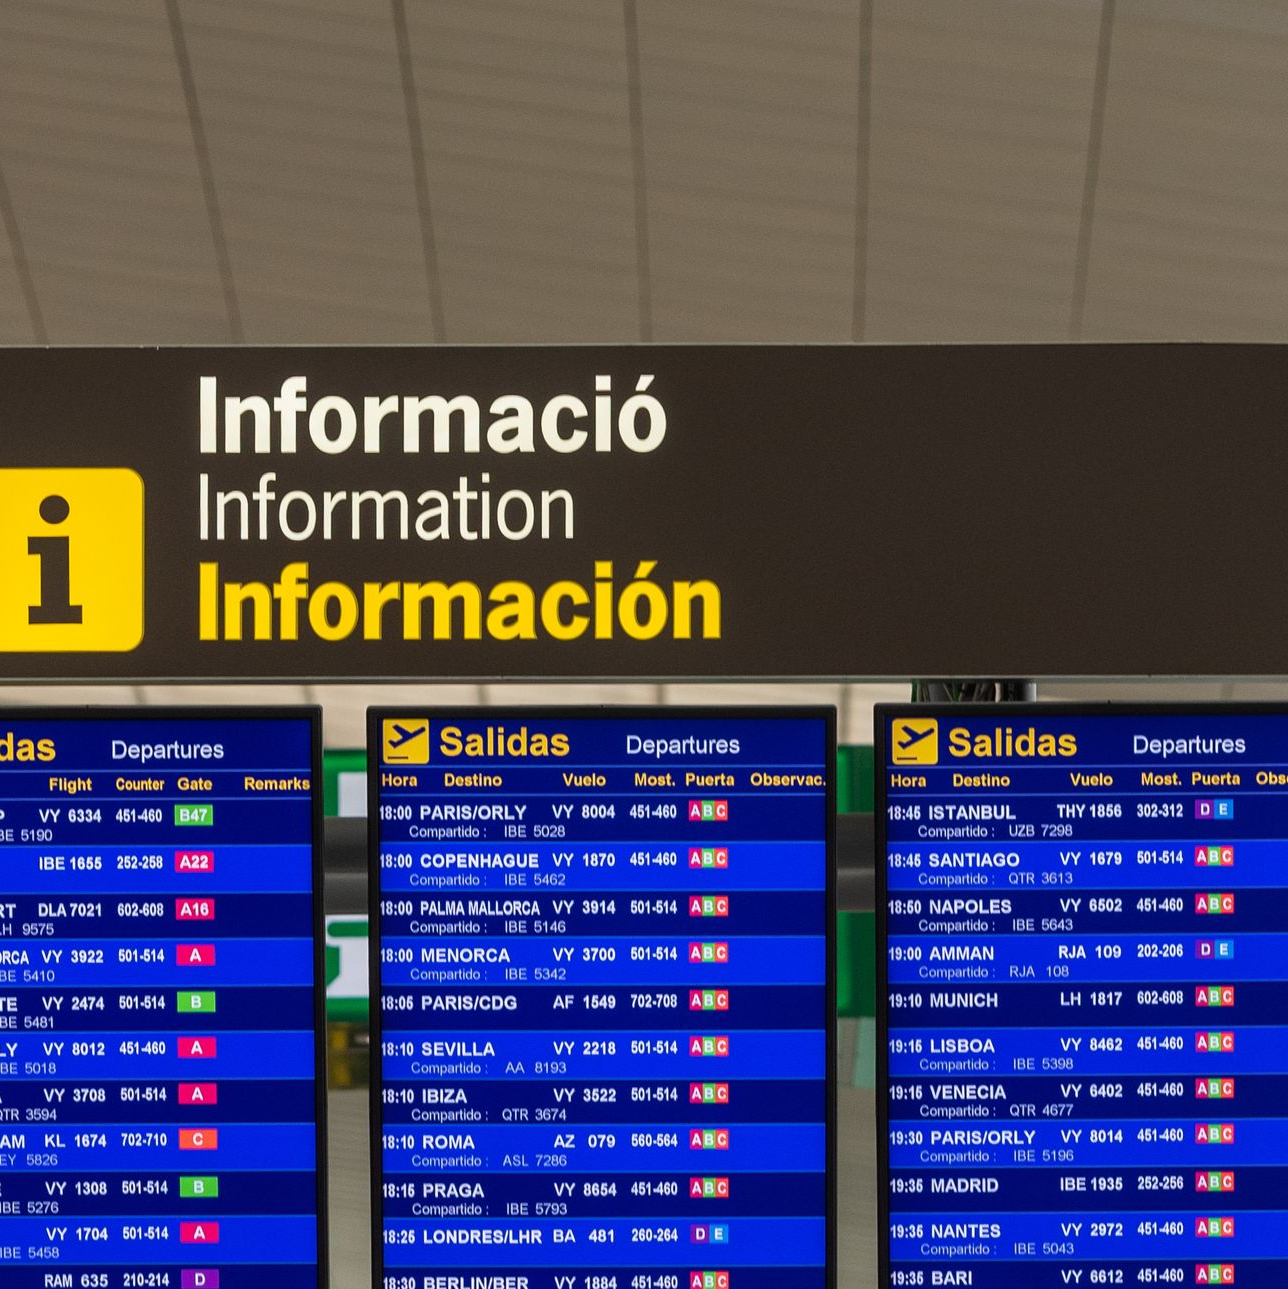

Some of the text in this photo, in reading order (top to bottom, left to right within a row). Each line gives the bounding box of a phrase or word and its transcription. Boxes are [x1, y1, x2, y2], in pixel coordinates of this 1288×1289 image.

[200, 375, 666, 454] Informació
[200, 472, 573, 540] Information
[200, 561, 720, 640] Información
[112, 741, 224, 763] Departures
[440, 727, 740, 758] Salidas Departures
[949, 728, 1245, 758] Salidas Departures
[49, 778, 92, 794] Flight
[116, 778, 164, 790] Counter
[177, 777, 212, 790] Gate
[245, 777, 310, 790] Remarks
[382, 773, 825, 786] Hora Destino Vuelo Most. Puerta Observac.
[891, 774, 926, 787] Hora
[953, 774, 1010, 787] Destino
[1070, 773, 1113, 786] Vuelo
[1142, 773, 1181, 785] Most.
[1192, 772, 1240, 785] Puerta
[379, 1042, 413, 1058] 18:10
[422, 1042, 495, 1056] SEVILLA
[554, 1042, 574, 1055] VY
[583, 1042, 615, 1055] 2218
[631, 1041, 677, 1054] 501-514
[46, 1228, 67, 1240] VY
[76, 1228, 108, 1240] 1704
[123, 1227, 168, 1239] 501-514
